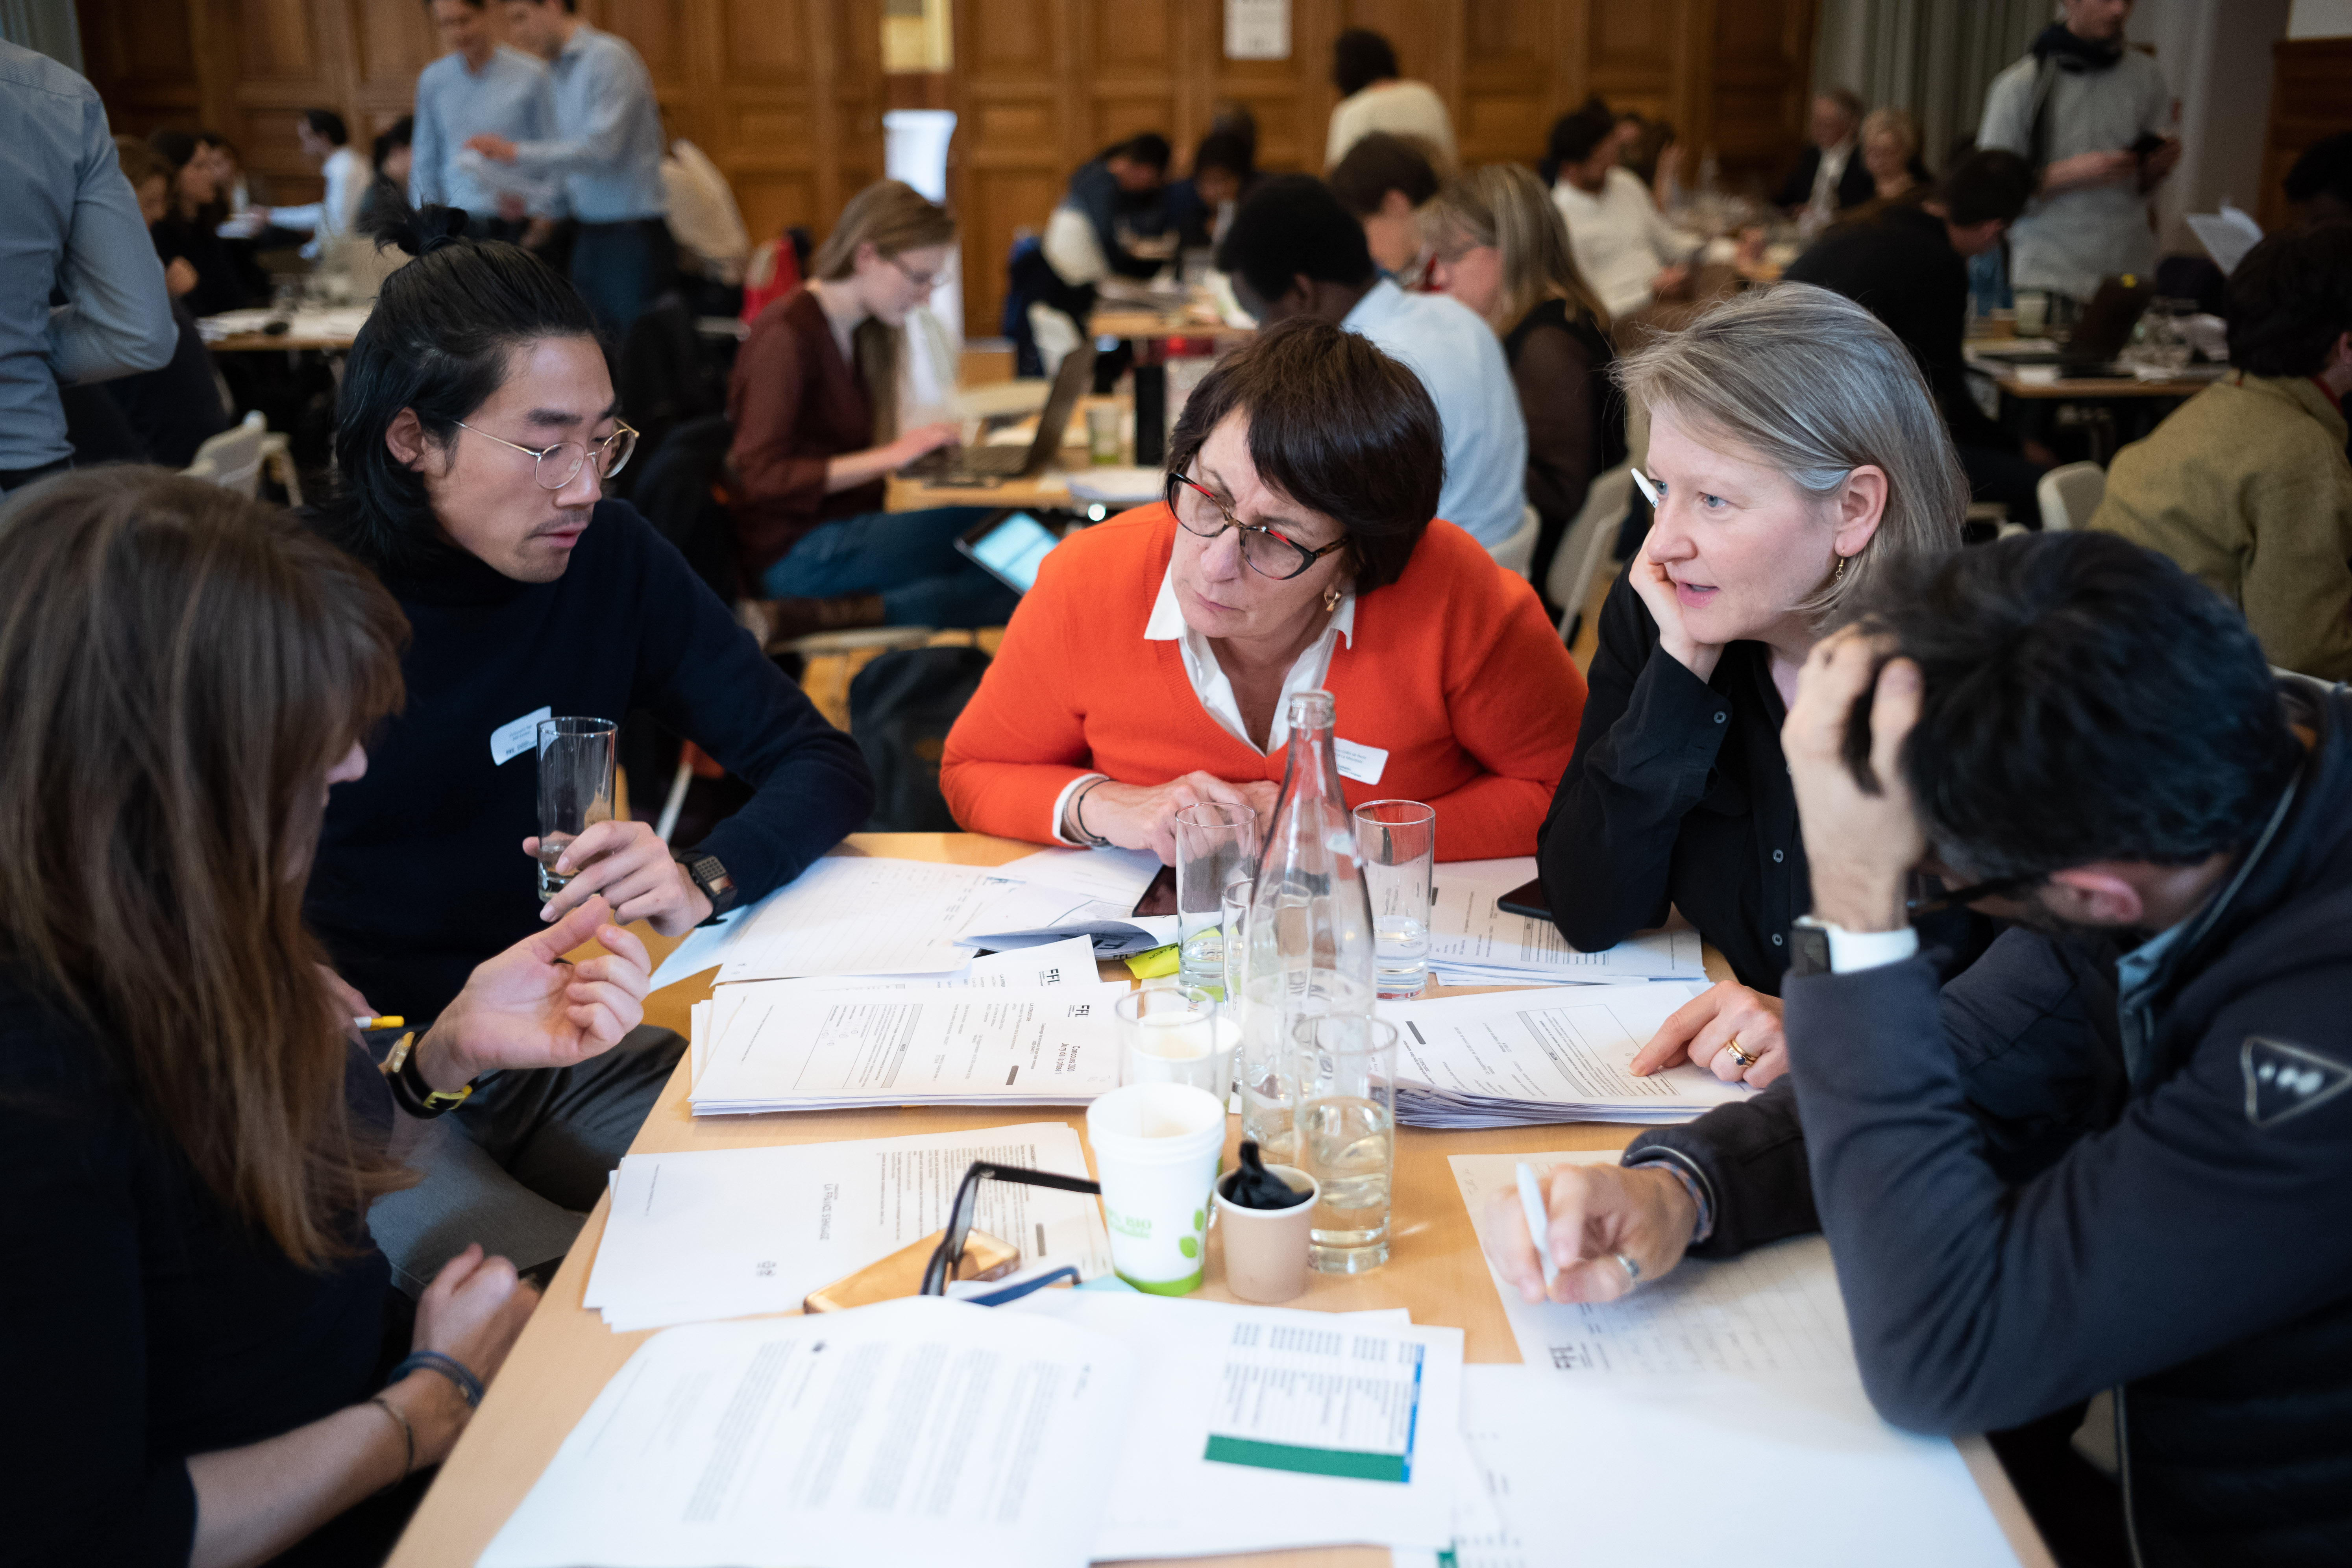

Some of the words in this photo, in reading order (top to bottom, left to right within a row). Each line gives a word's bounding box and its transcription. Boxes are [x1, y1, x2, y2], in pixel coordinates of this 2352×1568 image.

[1149, 949, 1167, 960] NEON
[1047, 969, 1061, 985] FFL
[1075, 1005, 1090, 1017] FFL
[1058, 1043, 1069, 1051] Jury
[1403, 1040, 1411, 1051] numérique
[1069, 1046, 1080, 1063] Concours
[1549, 1052, 1558, 1060] NOTES
[1055, 1061, 1064, 1071] phase
[1418, 1065, 1426, 1074] tiers-lieux
[822, 1192, 833, 1212] FRANCE
[820, 1214, 831, 1239] S'ENGAGE
